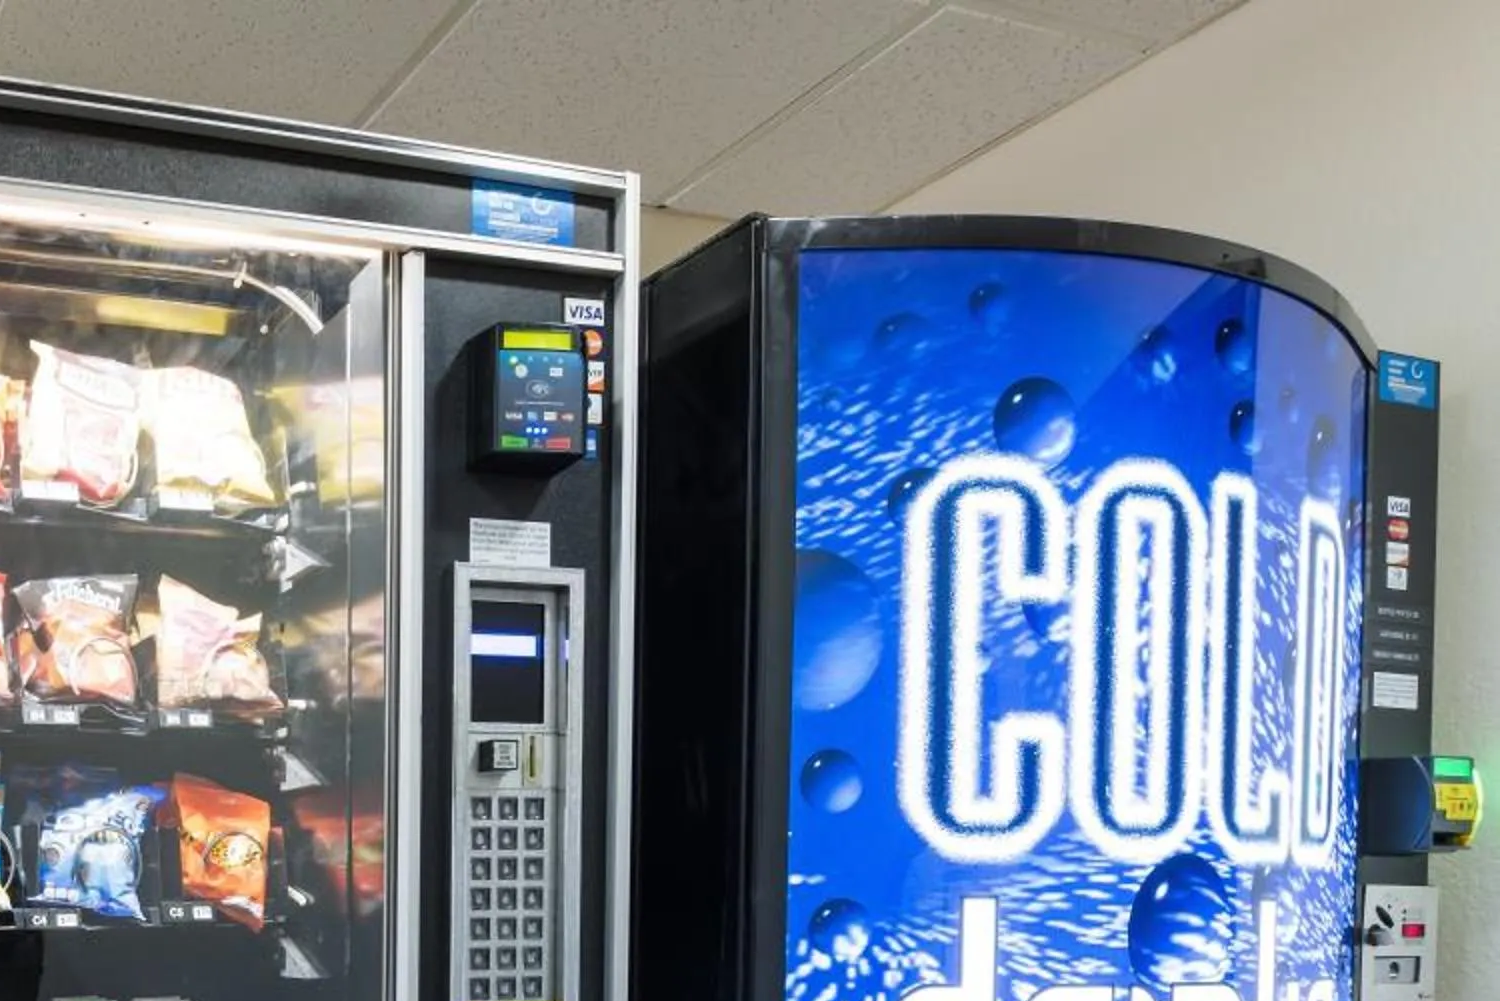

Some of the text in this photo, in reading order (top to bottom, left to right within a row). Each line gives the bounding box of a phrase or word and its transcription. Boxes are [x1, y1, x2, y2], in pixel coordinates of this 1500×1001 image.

[569, 304, 604, 321] VISA
[1389, 502, 1409, 513] VISA
[897, 452, 1347, 866] COLD
